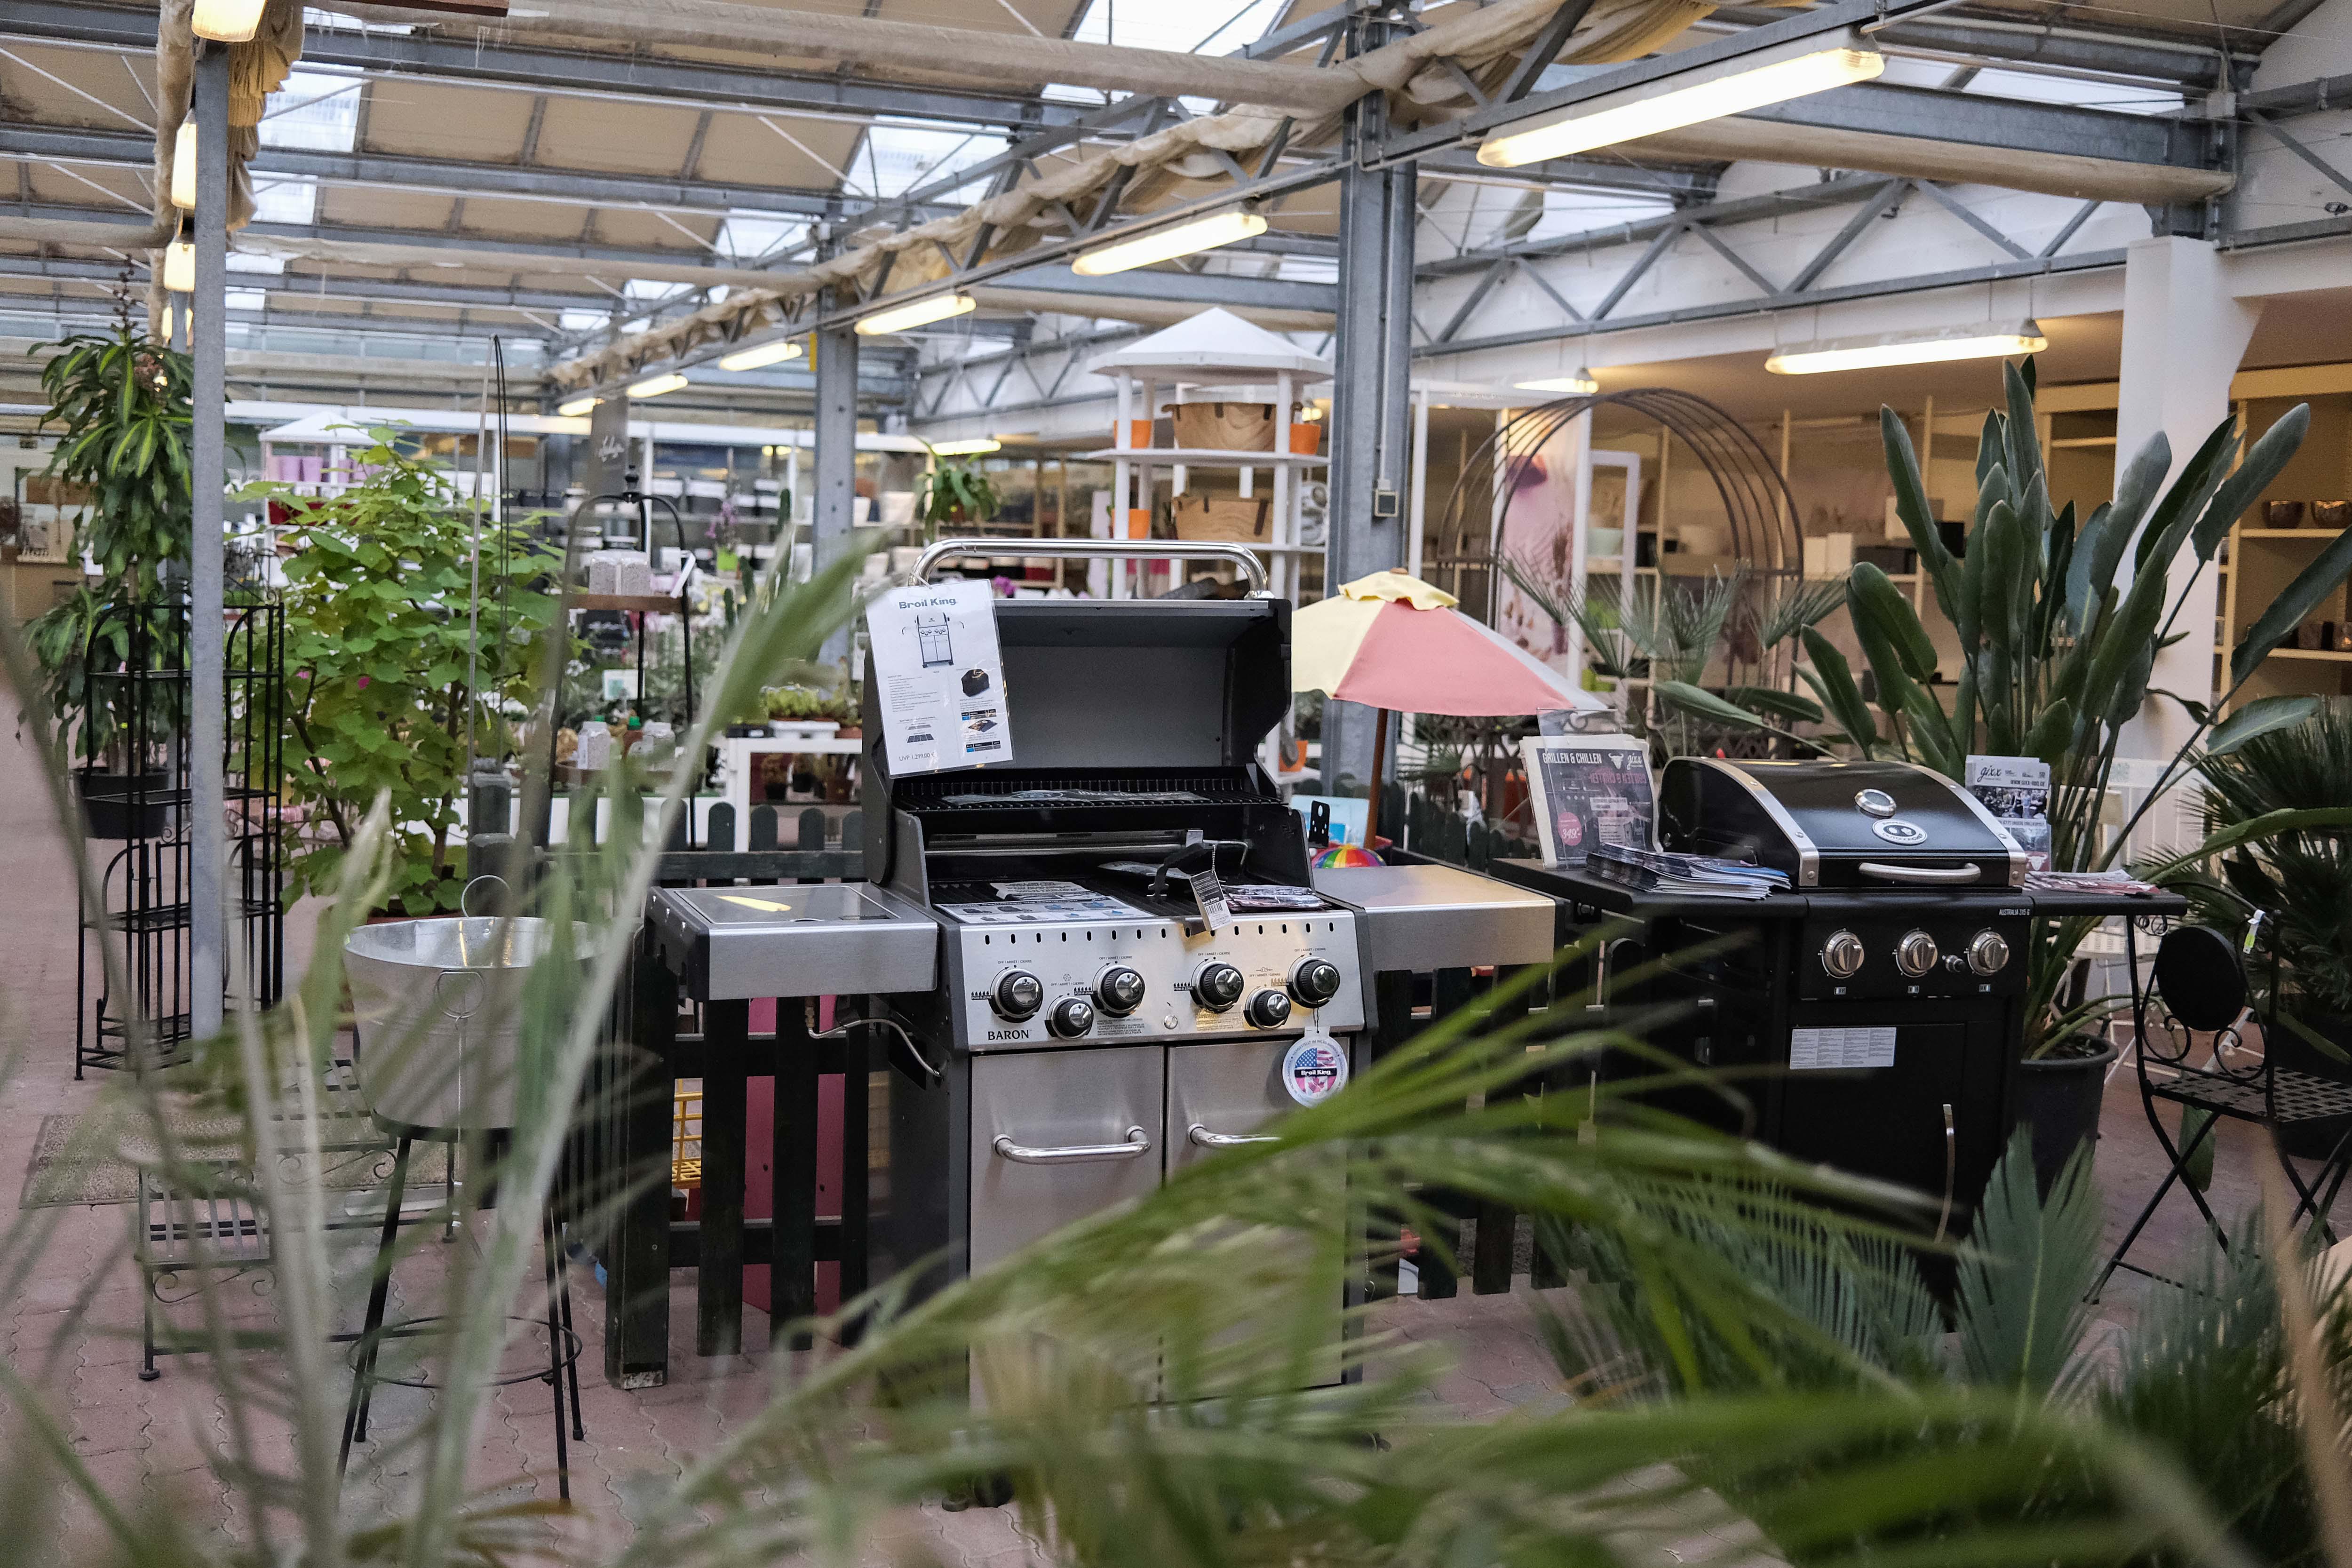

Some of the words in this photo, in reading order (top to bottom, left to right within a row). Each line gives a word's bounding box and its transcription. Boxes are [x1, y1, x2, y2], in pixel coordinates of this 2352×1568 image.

[898, 599, 928, 609] Broil
[1542, 753, 1569, 764] GRILLEN
[1570, 753, 1575, 764] &
[1576, 753, 1602, 764] CHILLEN
[1627, 753, 1642, 770] gixx
[1977, 765, 2002, 782] gixx
